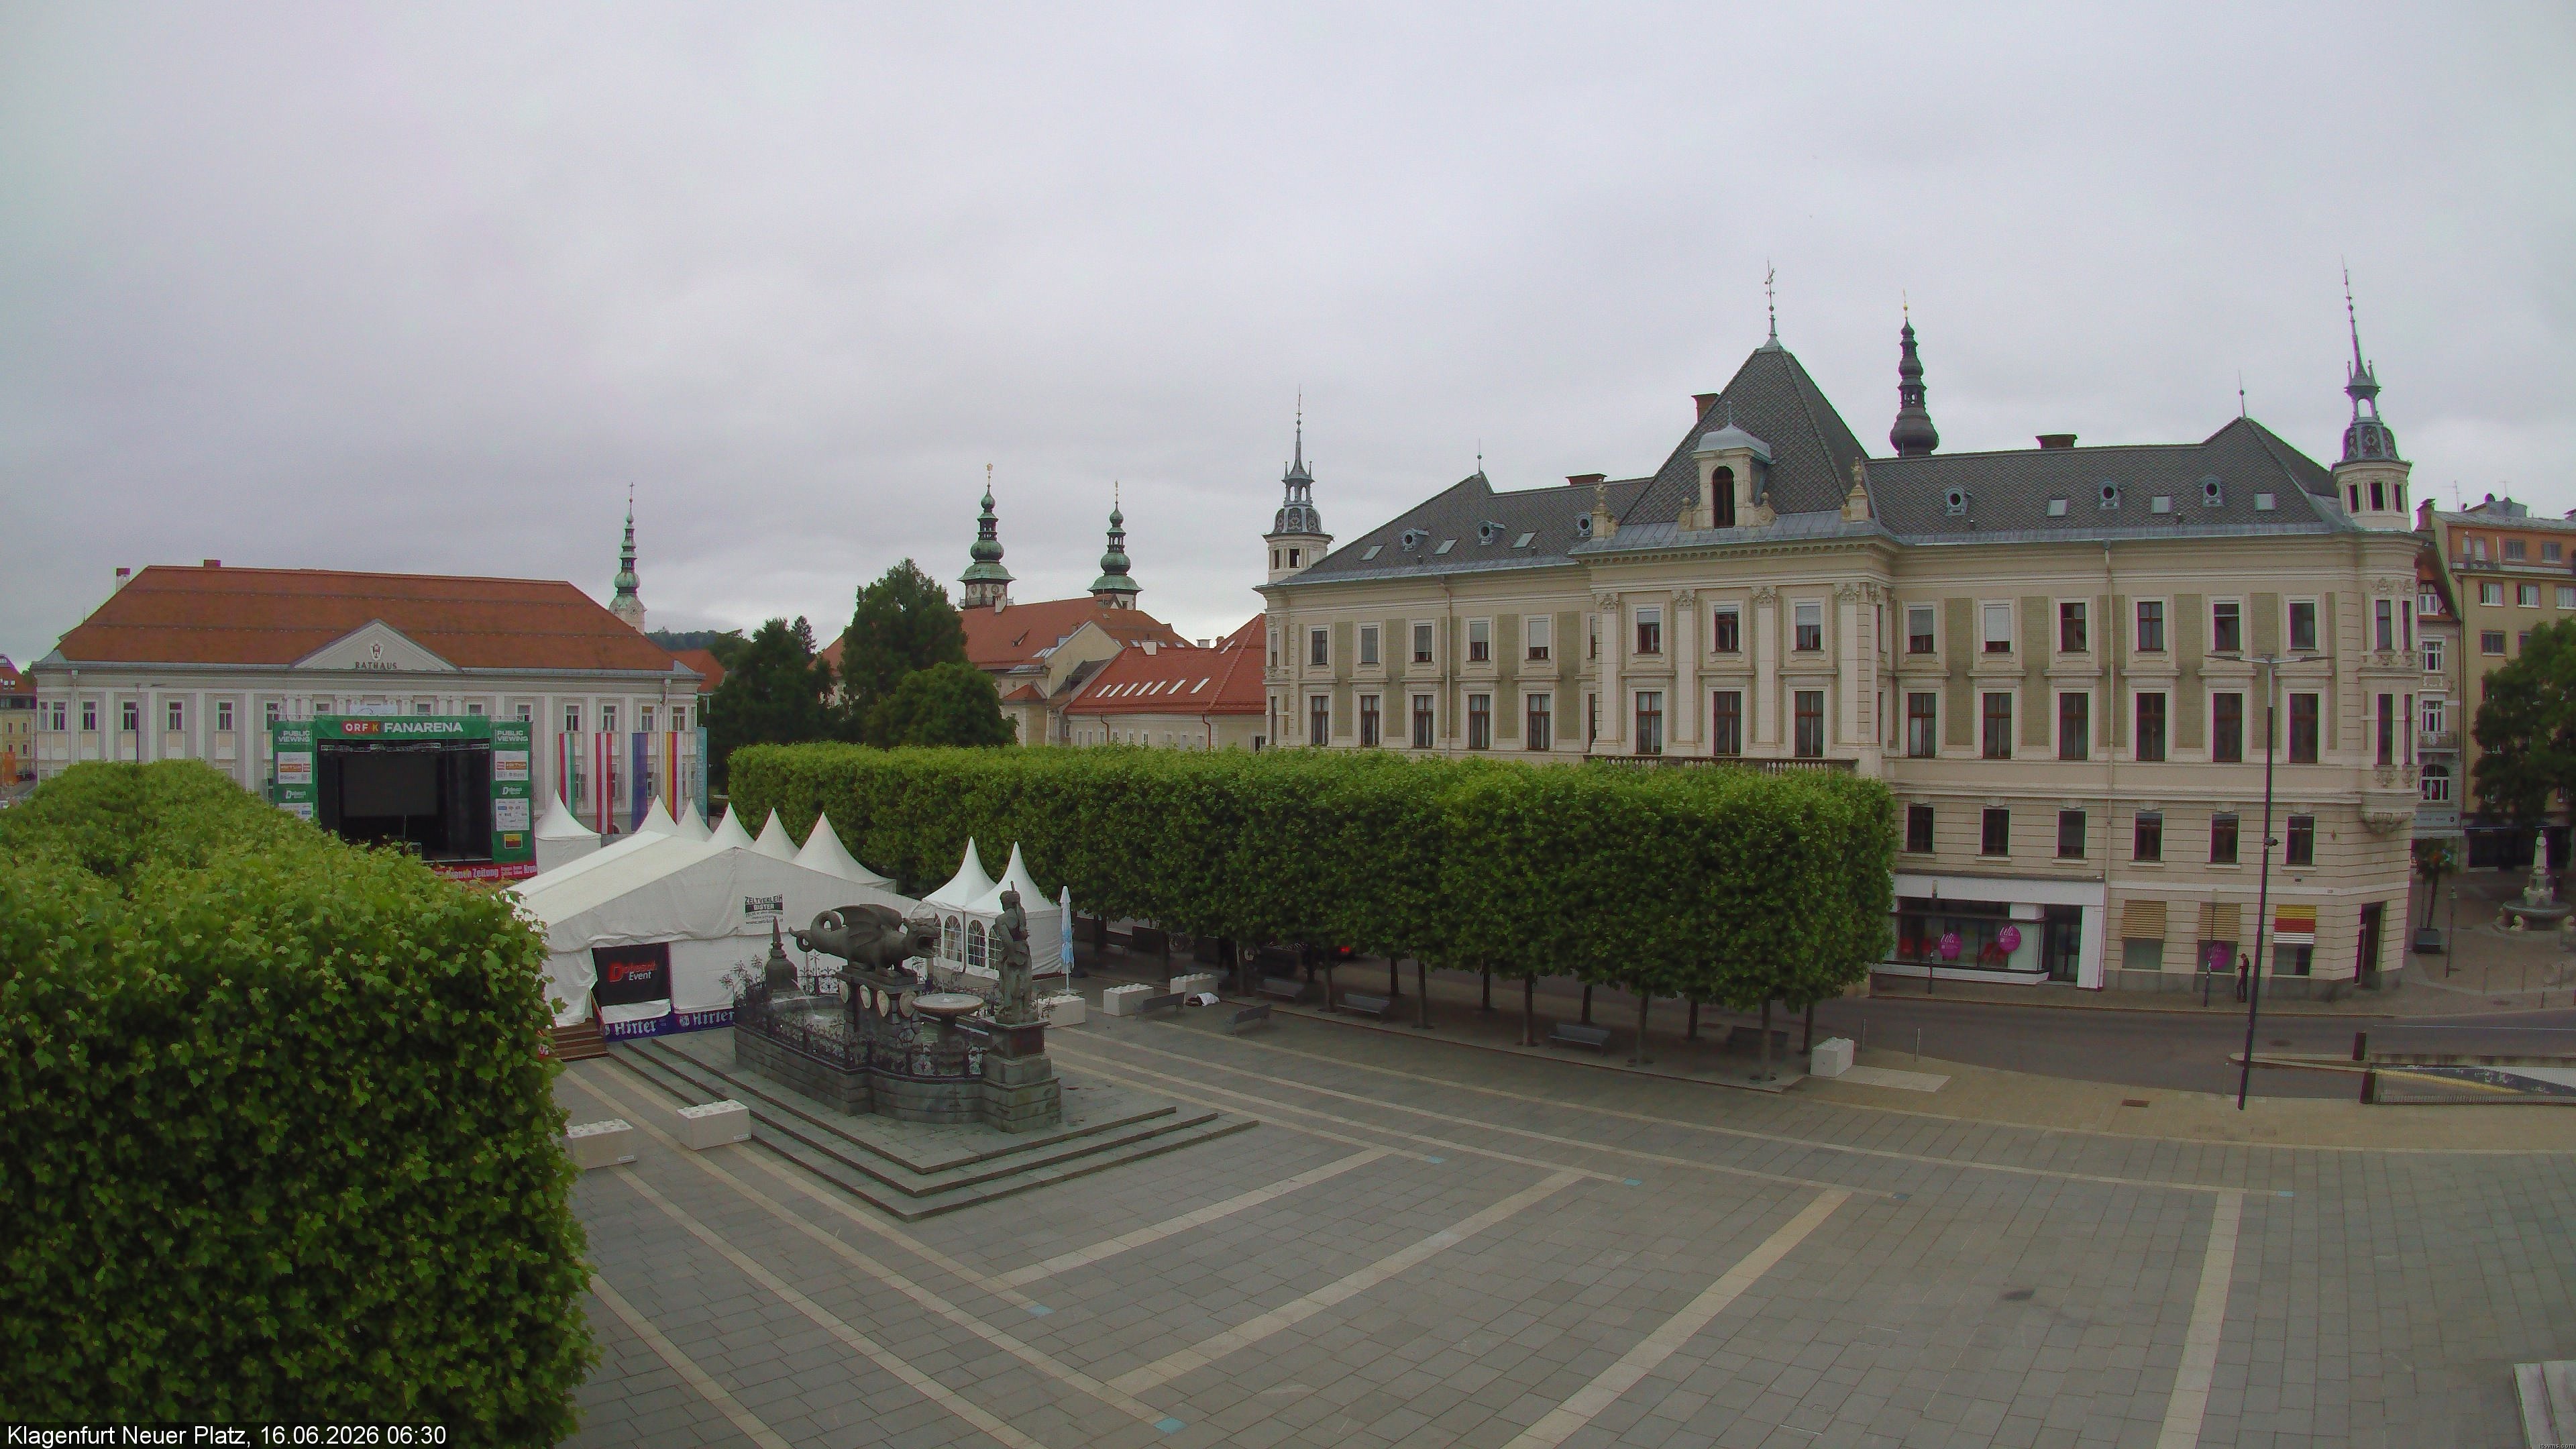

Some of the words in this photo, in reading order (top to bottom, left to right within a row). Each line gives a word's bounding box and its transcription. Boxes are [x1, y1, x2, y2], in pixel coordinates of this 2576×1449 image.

[355, 661, 397, 669] RATHAUS
[345, 723, 368, 732] ORF
[384, 722, 464, 733] FANARENA
[472, 867, 500, 878] Zeitung
[745, 893, 783, 904] ZELTVERLEIH
[629, 971, 651, 981] Event
